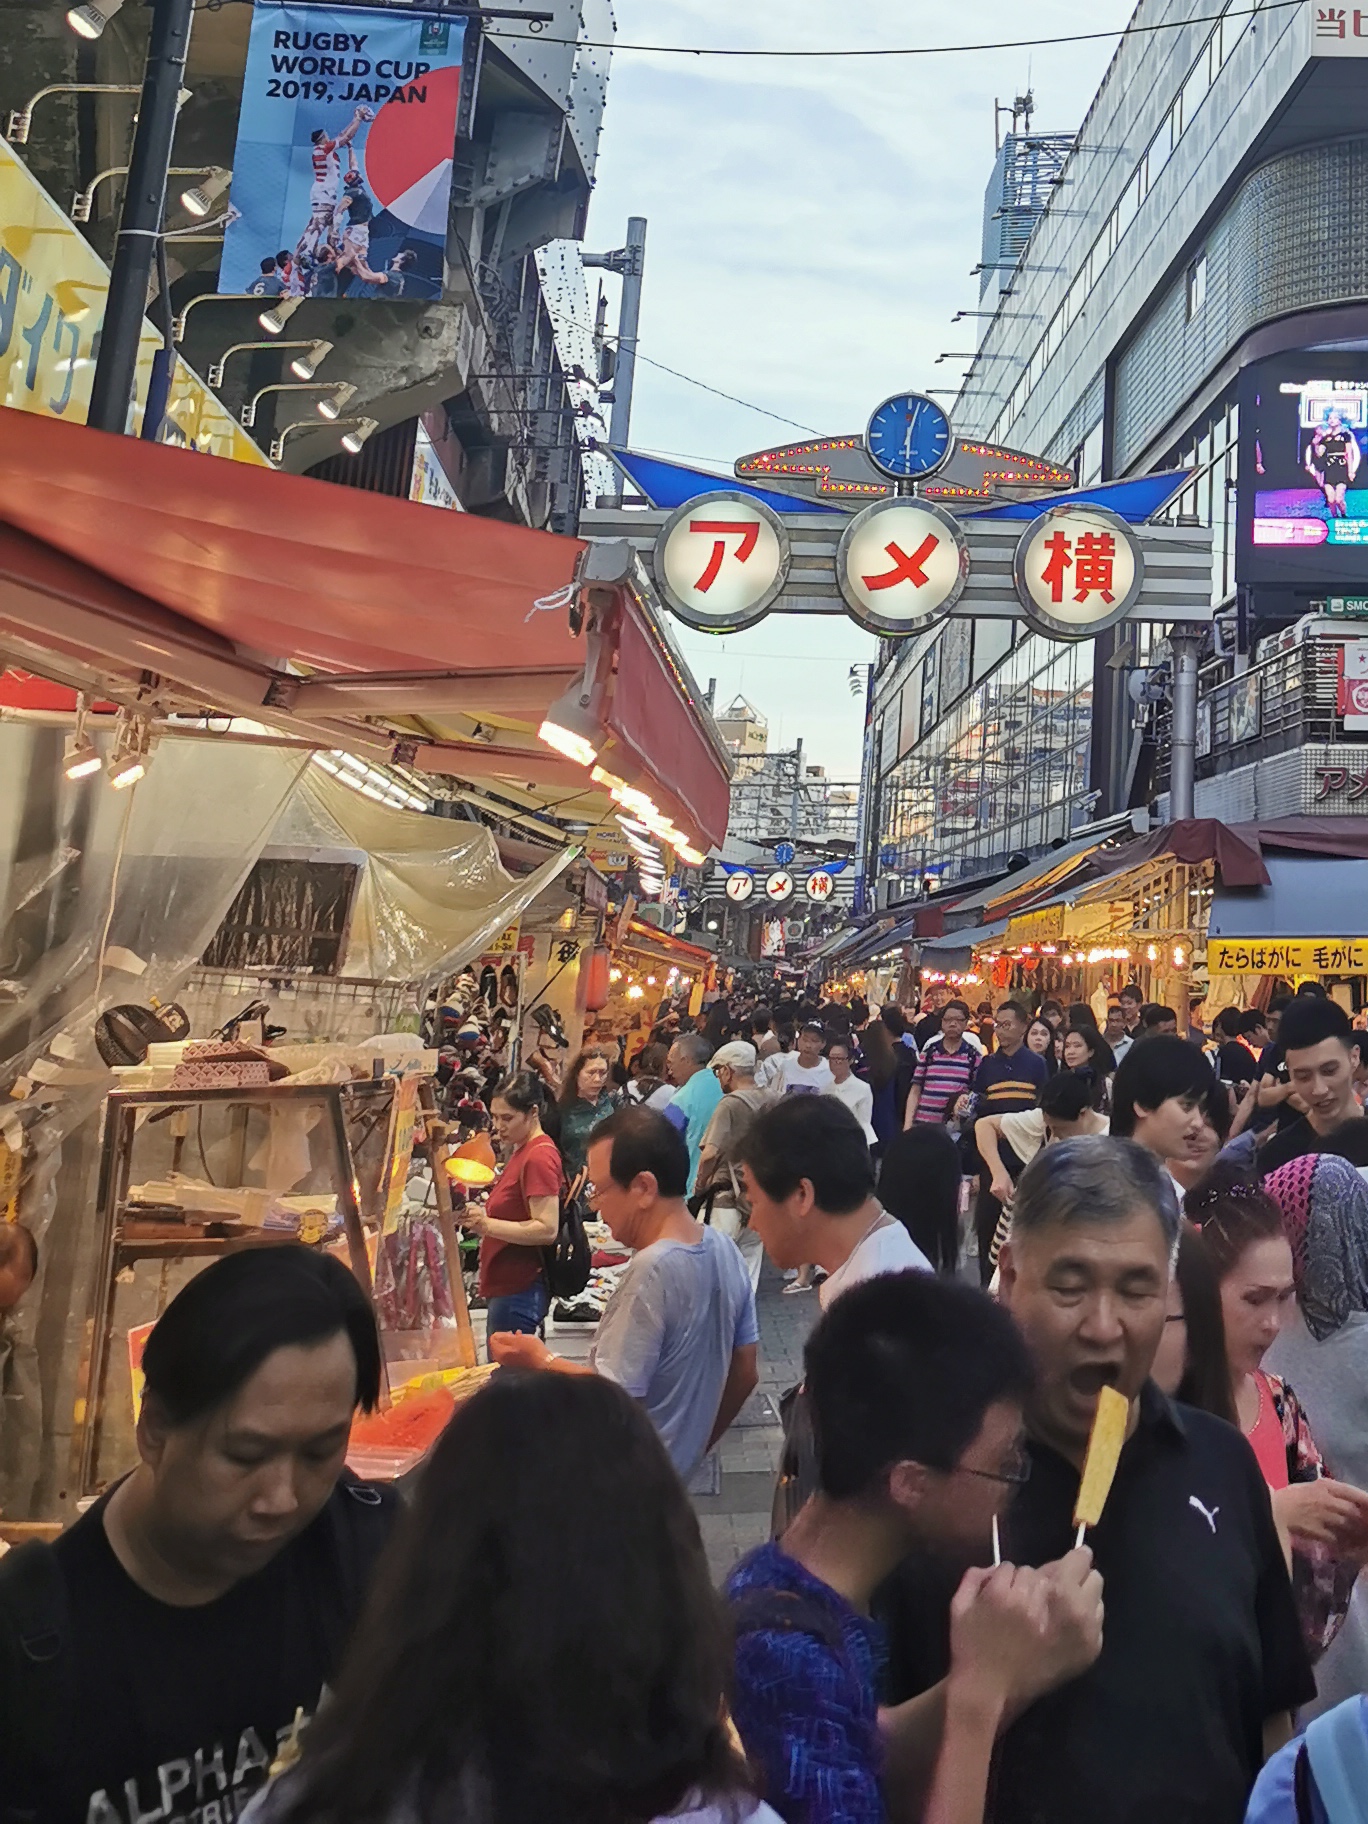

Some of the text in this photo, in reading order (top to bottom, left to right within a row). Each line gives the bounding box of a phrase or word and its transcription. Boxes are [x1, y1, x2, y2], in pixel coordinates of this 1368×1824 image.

[273, 30, 369, 53] RUGBY
[270, 54, 431, 80] WORLD CUP
[265, 79, 428, 104] 2019, JAPAN
[689, 519, 1117, 604] アメ横
[732, 876, 829, 895] アメ横
[1217, 946, 1301, 970] たらばがに
[1312, 946, 1364, 969] 毛がに
[86, 1726, 269, 1824] ALPHA
